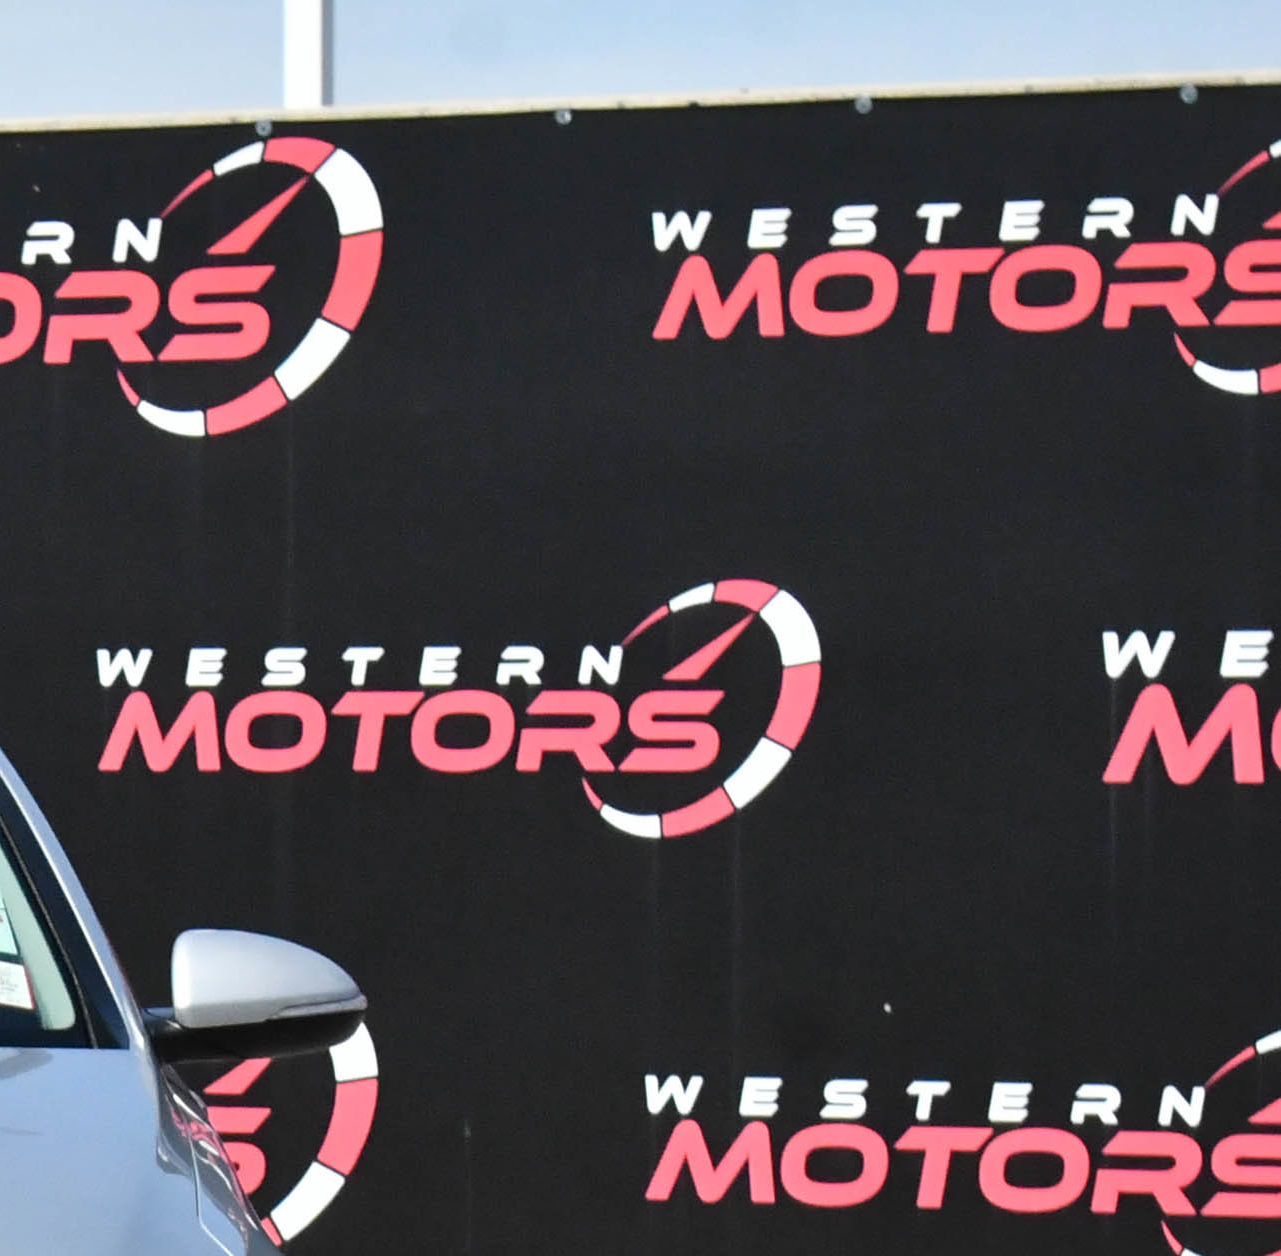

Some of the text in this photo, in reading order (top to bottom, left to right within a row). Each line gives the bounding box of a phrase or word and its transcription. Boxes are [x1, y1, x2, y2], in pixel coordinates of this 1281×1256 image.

[651, 193, 1219, 253] WESTERN
[96, 644, 623, 688] WESTERN
[1101, 629, 1275, 680] WE
[98, 688, 726, 775] MOTORS
[1101, 681, 1281, 787] M
[644, 1073, 1206, 1129] WESTERN
[644, 1117, 1281, 1220] MOTORS
